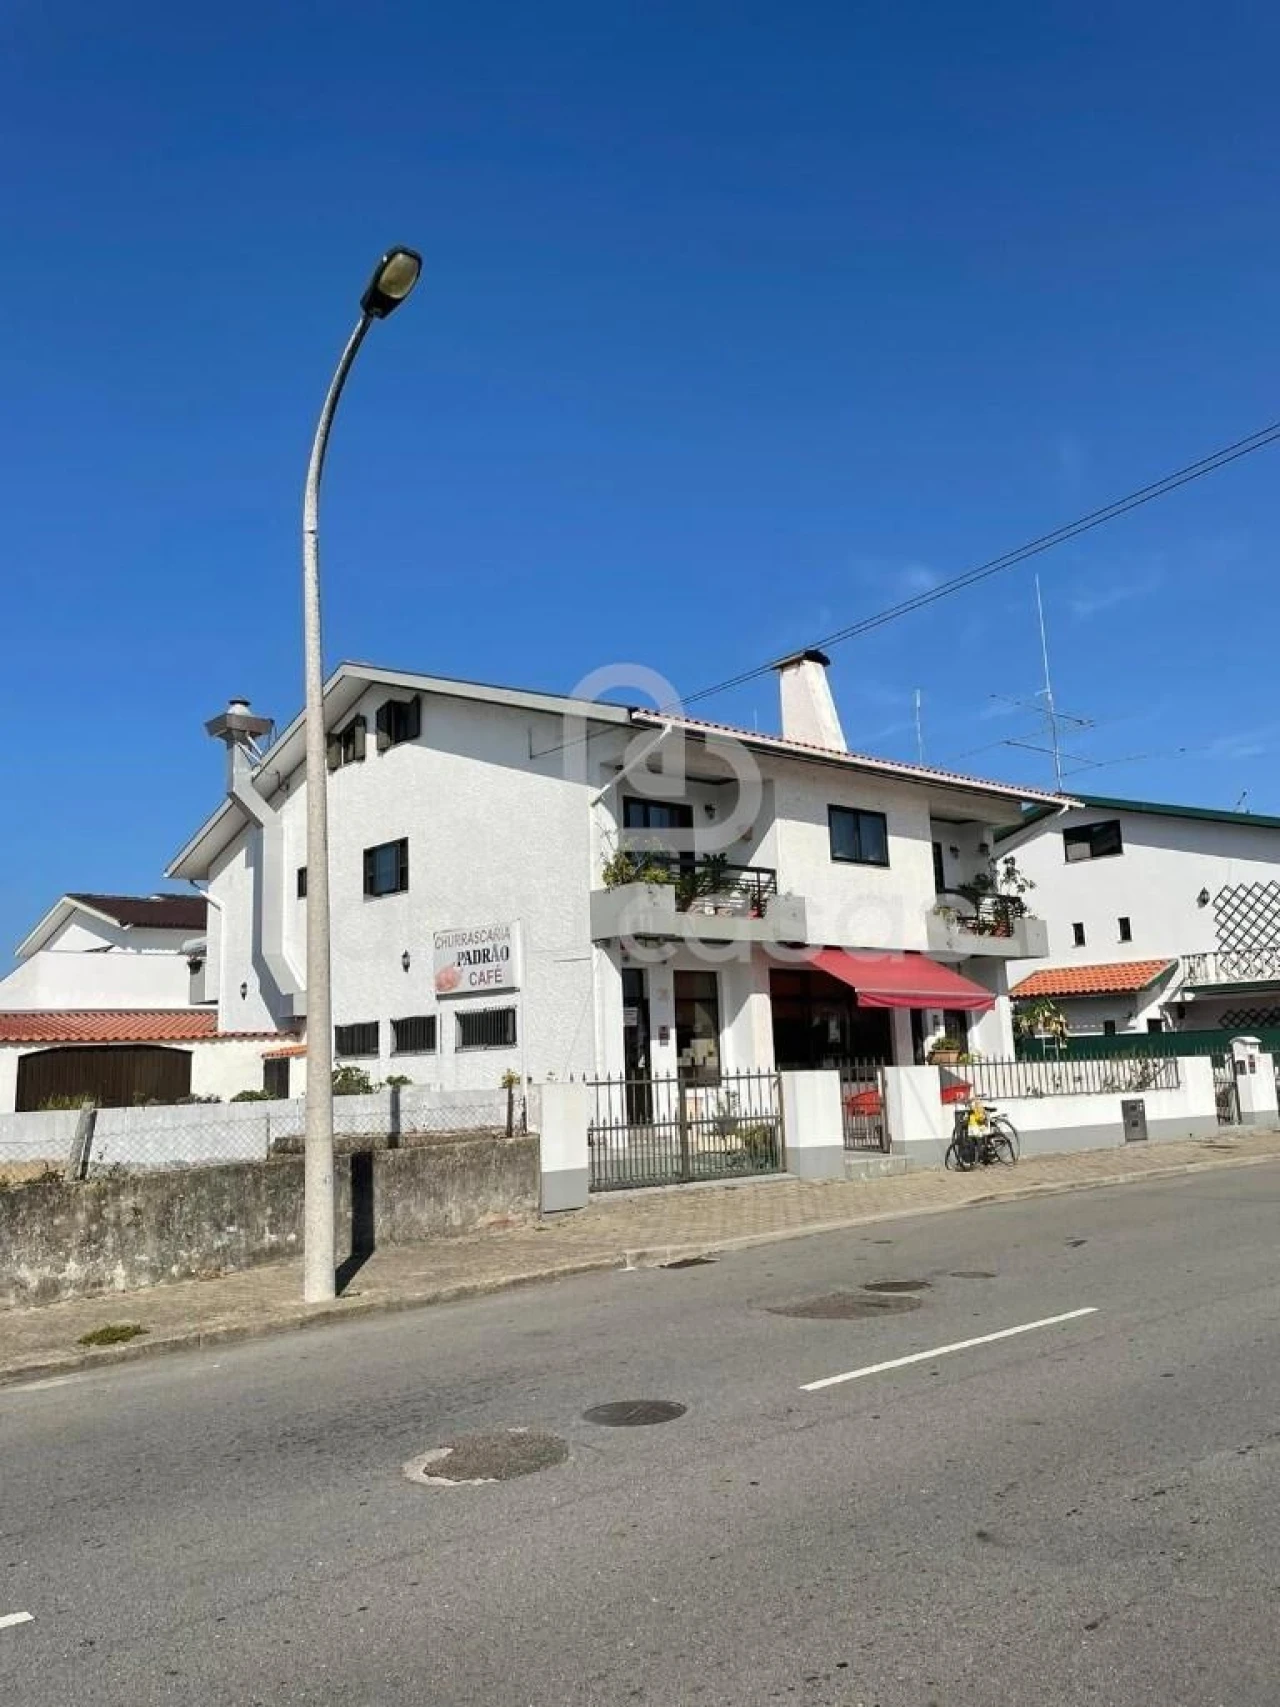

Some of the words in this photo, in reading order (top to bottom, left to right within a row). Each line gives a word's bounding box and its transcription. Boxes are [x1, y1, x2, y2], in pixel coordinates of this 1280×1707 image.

[435, 926, 510, 949] CHURRASCARIA
[457, 943, 509, 967] PADRÃO
[469, 965, 503, 986] CAFÉ
